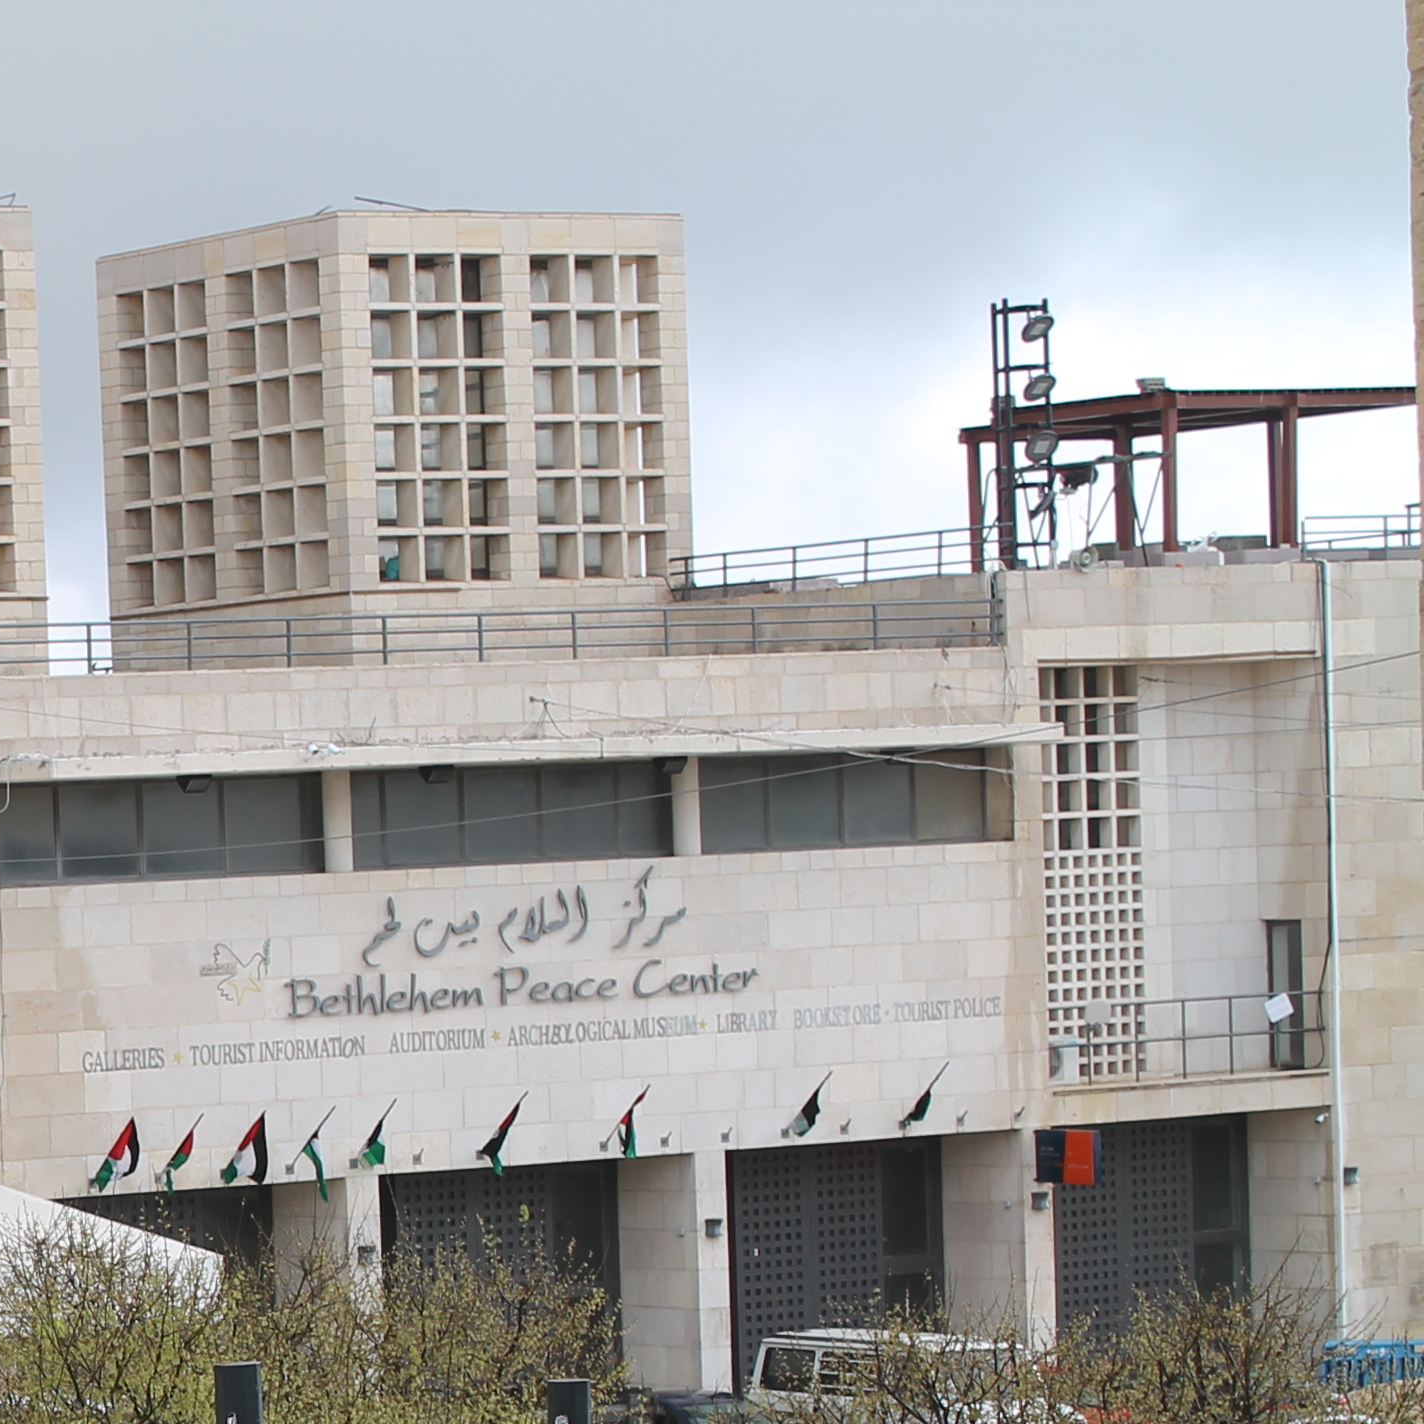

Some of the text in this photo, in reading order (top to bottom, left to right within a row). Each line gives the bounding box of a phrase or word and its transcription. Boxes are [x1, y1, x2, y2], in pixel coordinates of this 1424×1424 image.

[362, 865, 687, 967] مركز السلام بيت لحم
[284, 959, 760, 1018] Bethlehem Peace Center
[81, 1047, 165, 1073] GALLERIES
[189, 1042, 255, 1067] TOURIST
[258, 1035, 366, 1063] INFORMATION
[389, 1028, 486, 1054] AUDITORIUM
[633, 1013, 699, 1039] MUSEUM
[716, 1010, 779, 1034] LIBRARY
[793, 1003, 882, 1029] BOOKSTORE
[892, 1000, 951, 1023] TOURIST
[953, 996, 1002, 1019] POLICE
